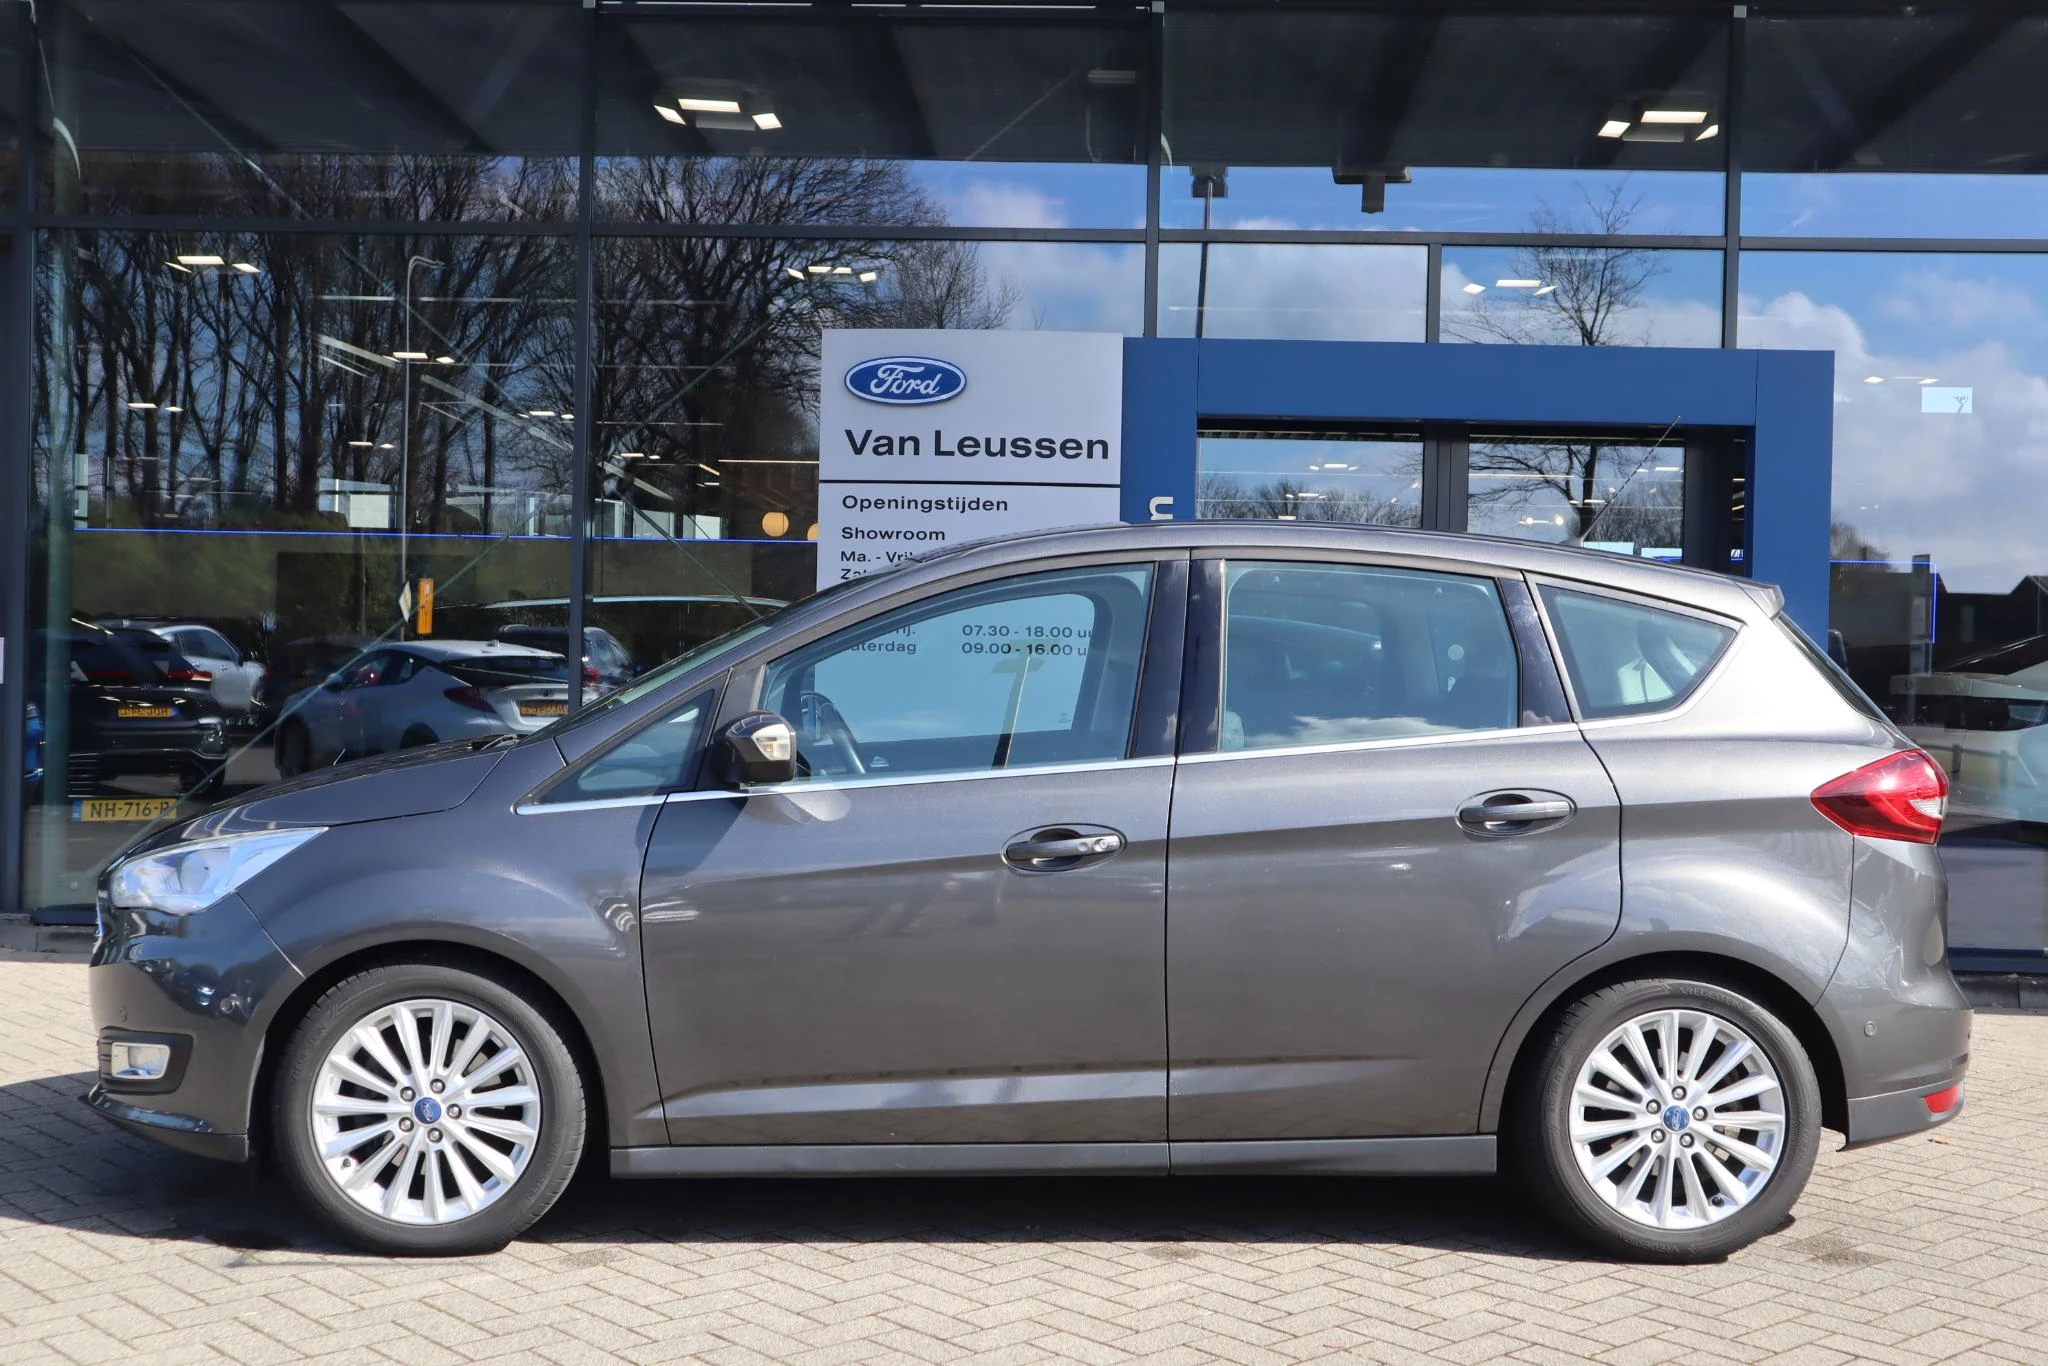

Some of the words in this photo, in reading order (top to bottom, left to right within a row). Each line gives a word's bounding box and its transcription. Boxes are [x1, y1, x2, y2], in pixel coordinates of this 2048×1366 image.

[869, 364, 942, 394] Ford
[844, 429, 920, 457] Van
[934, 429, 1109, 460] Leussen
[842, 494, 1008, 514] Openingstijden
[841, 526, 946, 541] Showroom
[841, 550, 871, 563] Ma.
[961, 624, 1010, 637] 07.30
[1025, 625, 1073, 639] 18.00
[961, 642, 1012, 655] 09.00
[1025, 643, 1073, 656] 16.00
